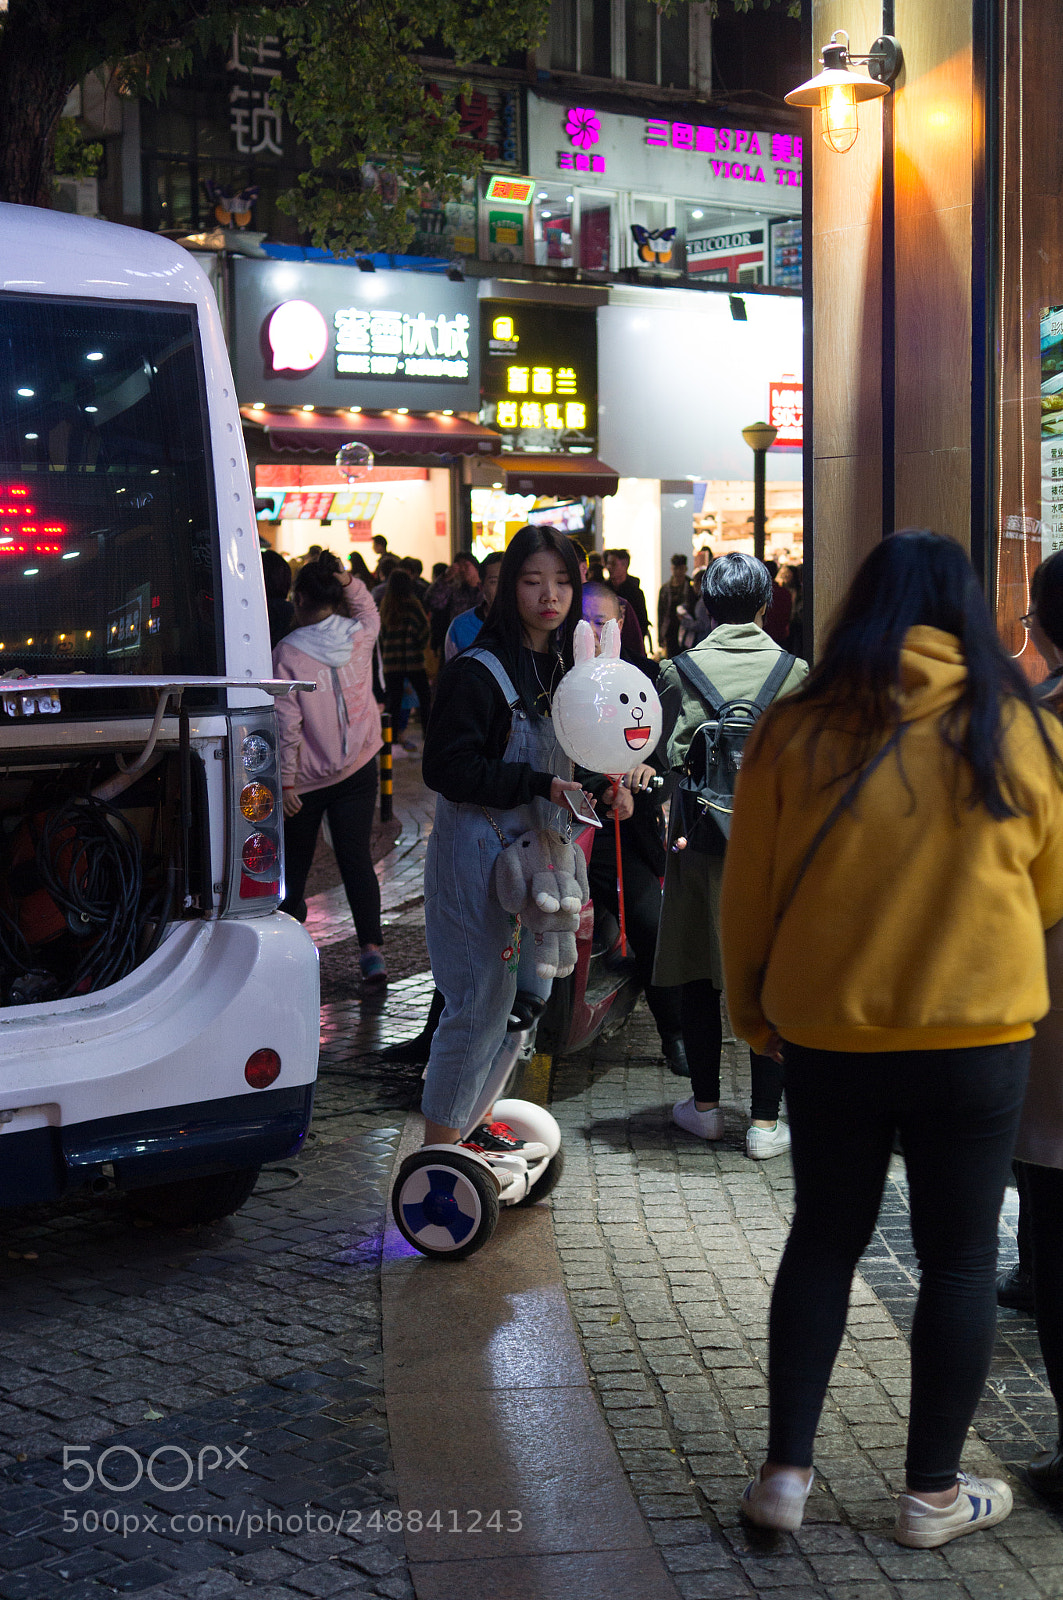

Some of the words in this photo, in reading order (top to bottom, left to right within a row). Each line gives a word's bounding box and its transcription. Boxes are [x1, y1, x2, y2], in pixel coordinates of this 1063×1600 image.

[711, 160, 766, 183] VIOLA
[687, 232, 752, 253] TRICOLOR
[334, 307, 470, 358] 蜜雪冰城
